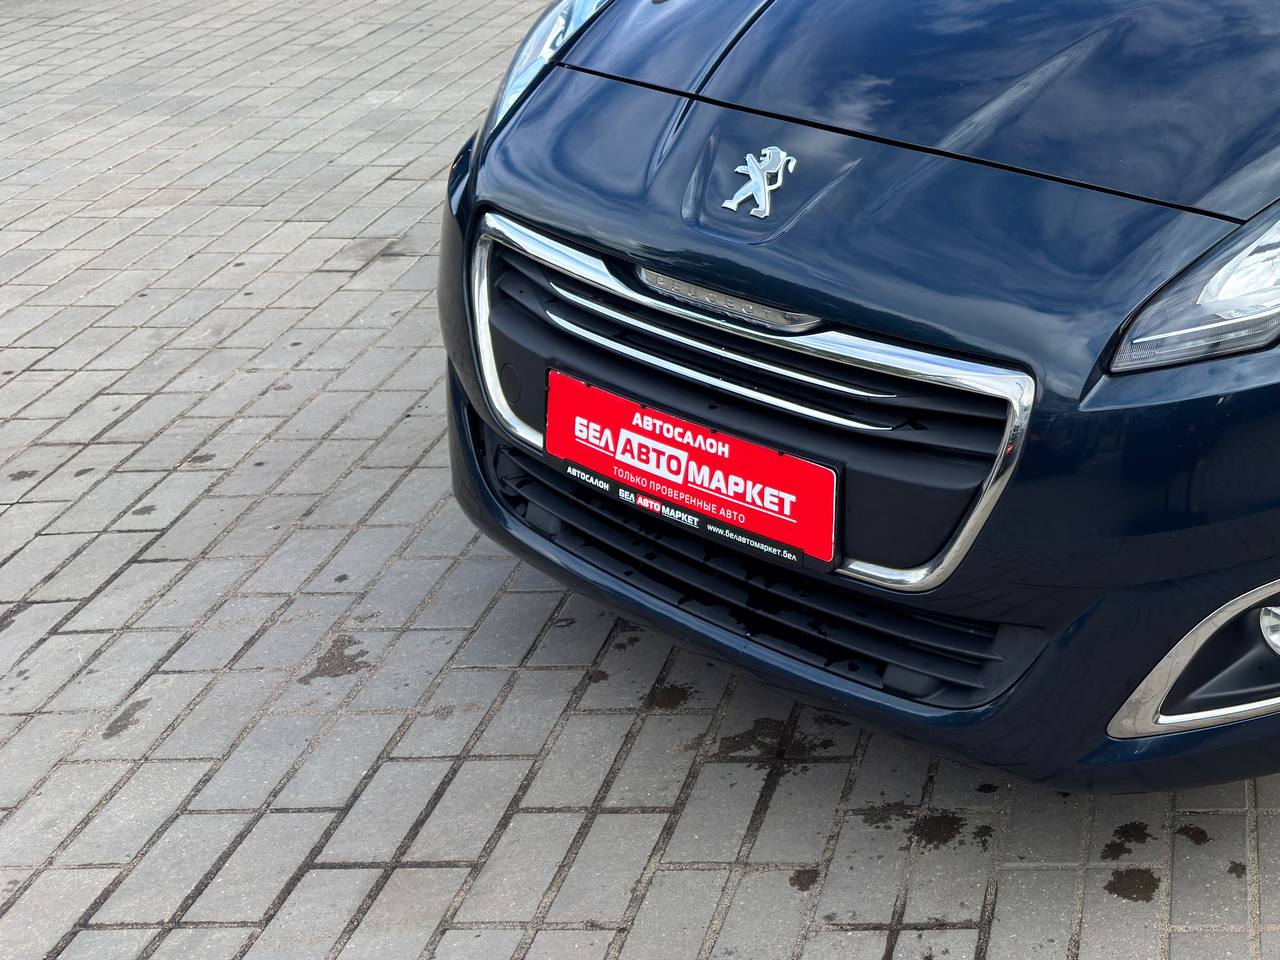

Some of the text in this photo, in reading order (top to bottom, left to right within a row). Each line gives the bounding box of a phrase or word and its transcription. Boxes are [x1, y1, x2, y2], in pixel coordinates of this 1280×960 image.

[574, 415, 797, 517] БЕЛ АВТО МАРКЕТ
[631, 412, 730, 459] АВТОСАЛОН
[566, 465, 798, 562] АВТОСАЛОН БЕЛ АВТО МАРКЕТ www.белавтомаркет.бел
[612, 465, 746, 524] ТОЛЬКО ПРОВЕРЕННЫЕ АВТО
